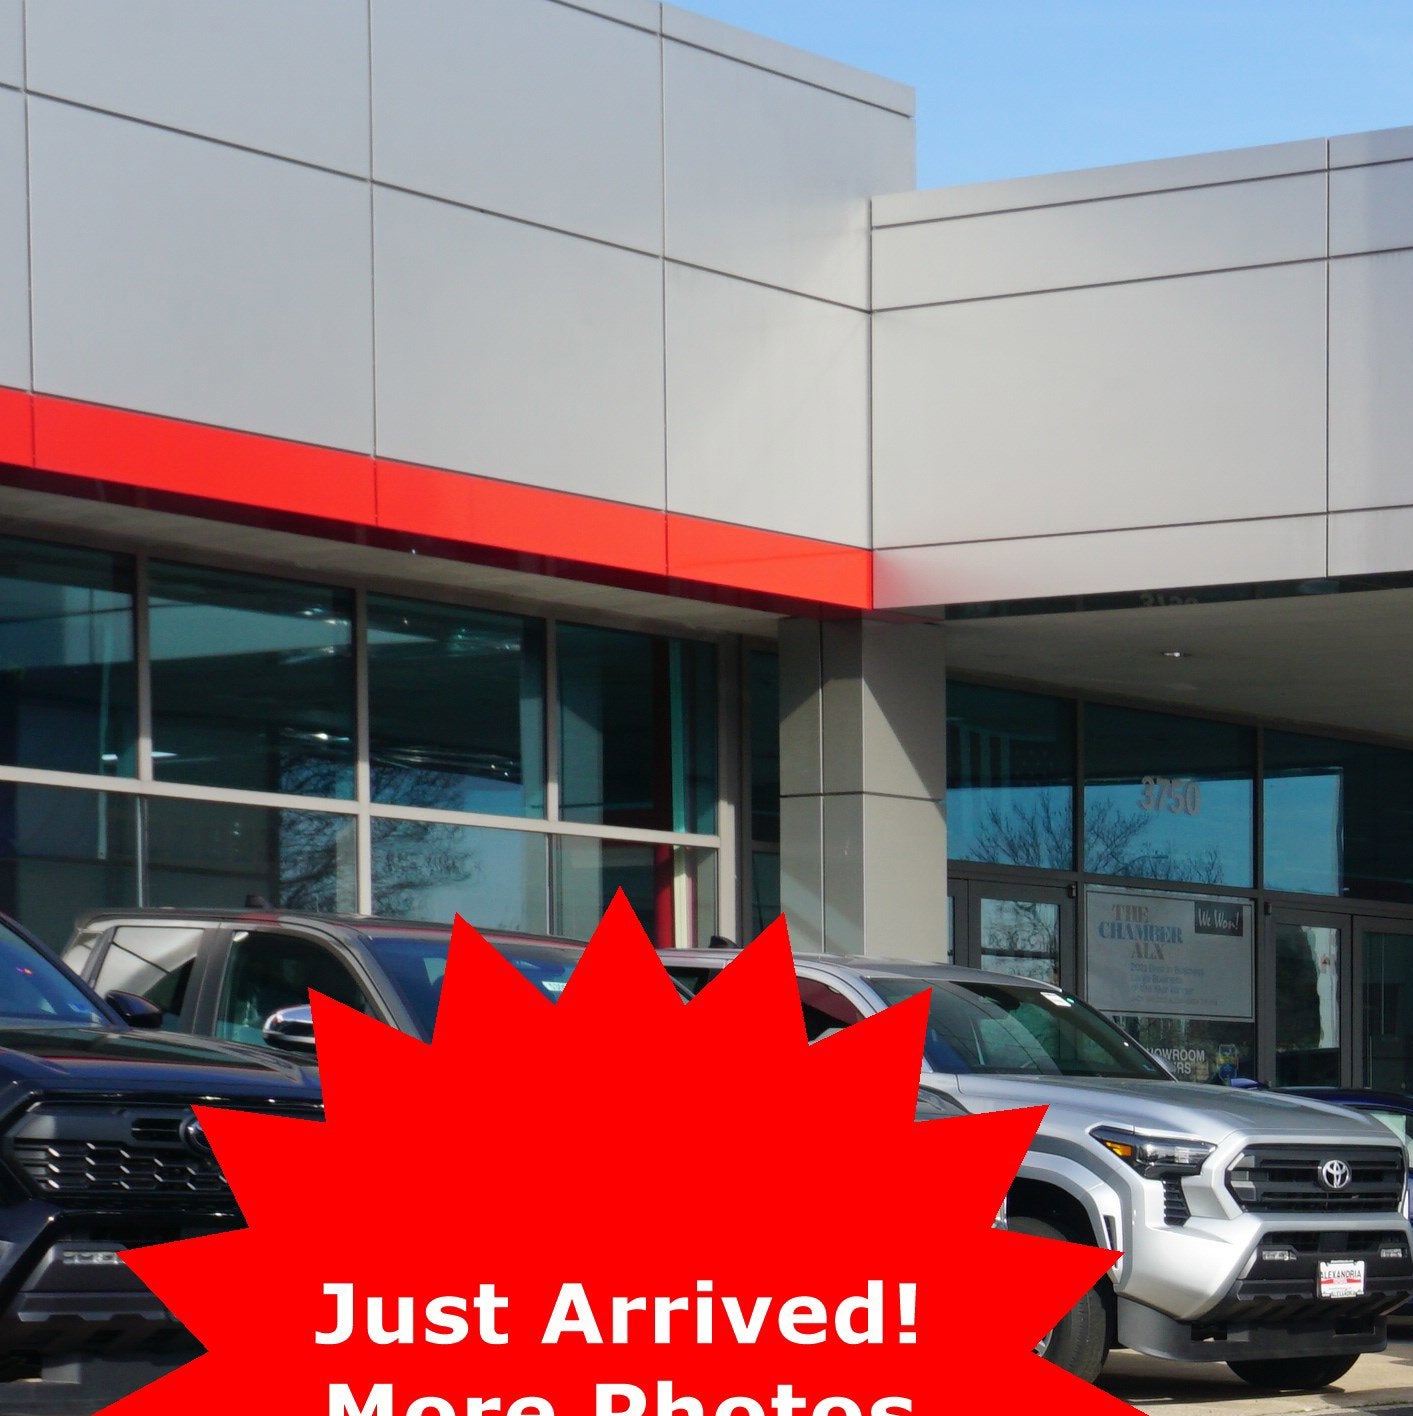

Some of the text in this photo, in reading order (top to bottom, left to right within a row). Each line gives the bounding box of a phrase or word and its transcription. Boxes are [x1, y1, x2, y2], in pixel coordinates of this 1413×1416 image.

[1138, 775, 1200, 816] 3750
[1112, 904, 1149, 923] THE
[1198, 908, 1240, 930] We Won!
[1098, 921, 1183, 944] CHAMBER
[1132, 941, 1165, 960] ALX
[1320, 1269, 1362, 1279] ALEXANDRIA
